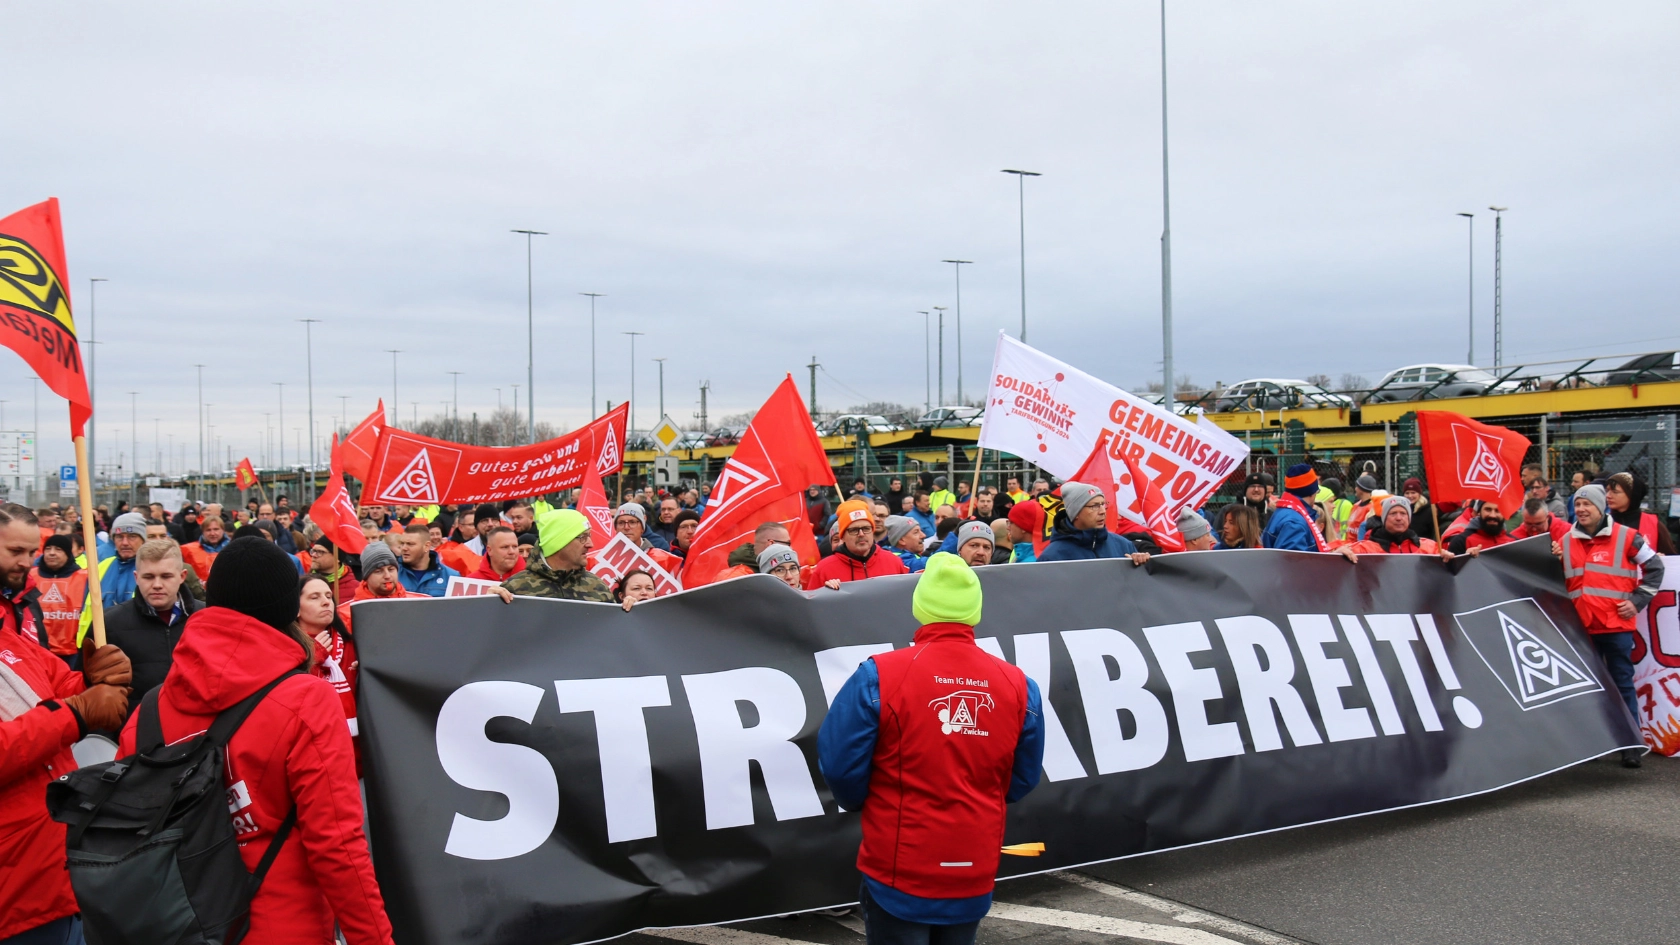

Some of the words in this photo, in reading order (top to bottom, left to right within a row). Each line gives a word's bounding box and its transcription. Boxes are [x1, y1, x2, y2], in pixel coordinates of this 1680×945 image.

[1011, 408, 1056, 433] TARIFBEWEGUNG
[1056, 428, 1070, 440] 2024
[1014, 395, 1073, 432] GEWINNT
[1095, 427, 1146, 467] FÜR
[1108, 399, 1235, 477] GEMEINSAM
[468, 460, 519, 475] gutes
[556, 438, 580, 459] und
[63, 467, 74, 479] P
[488, 491, 507, 501] für
[508, 487, 533, 497] land
[533, 482, 553, 493] und
[553, 474, 582, 488] leute!
[489, 473, 528, 490] gute
[933, 675, 955, 685] Team
[956, 677, 964, 685] IG
[965, 678, 989, 688] Metall
[963, 727, 989, 737] Zwickau
